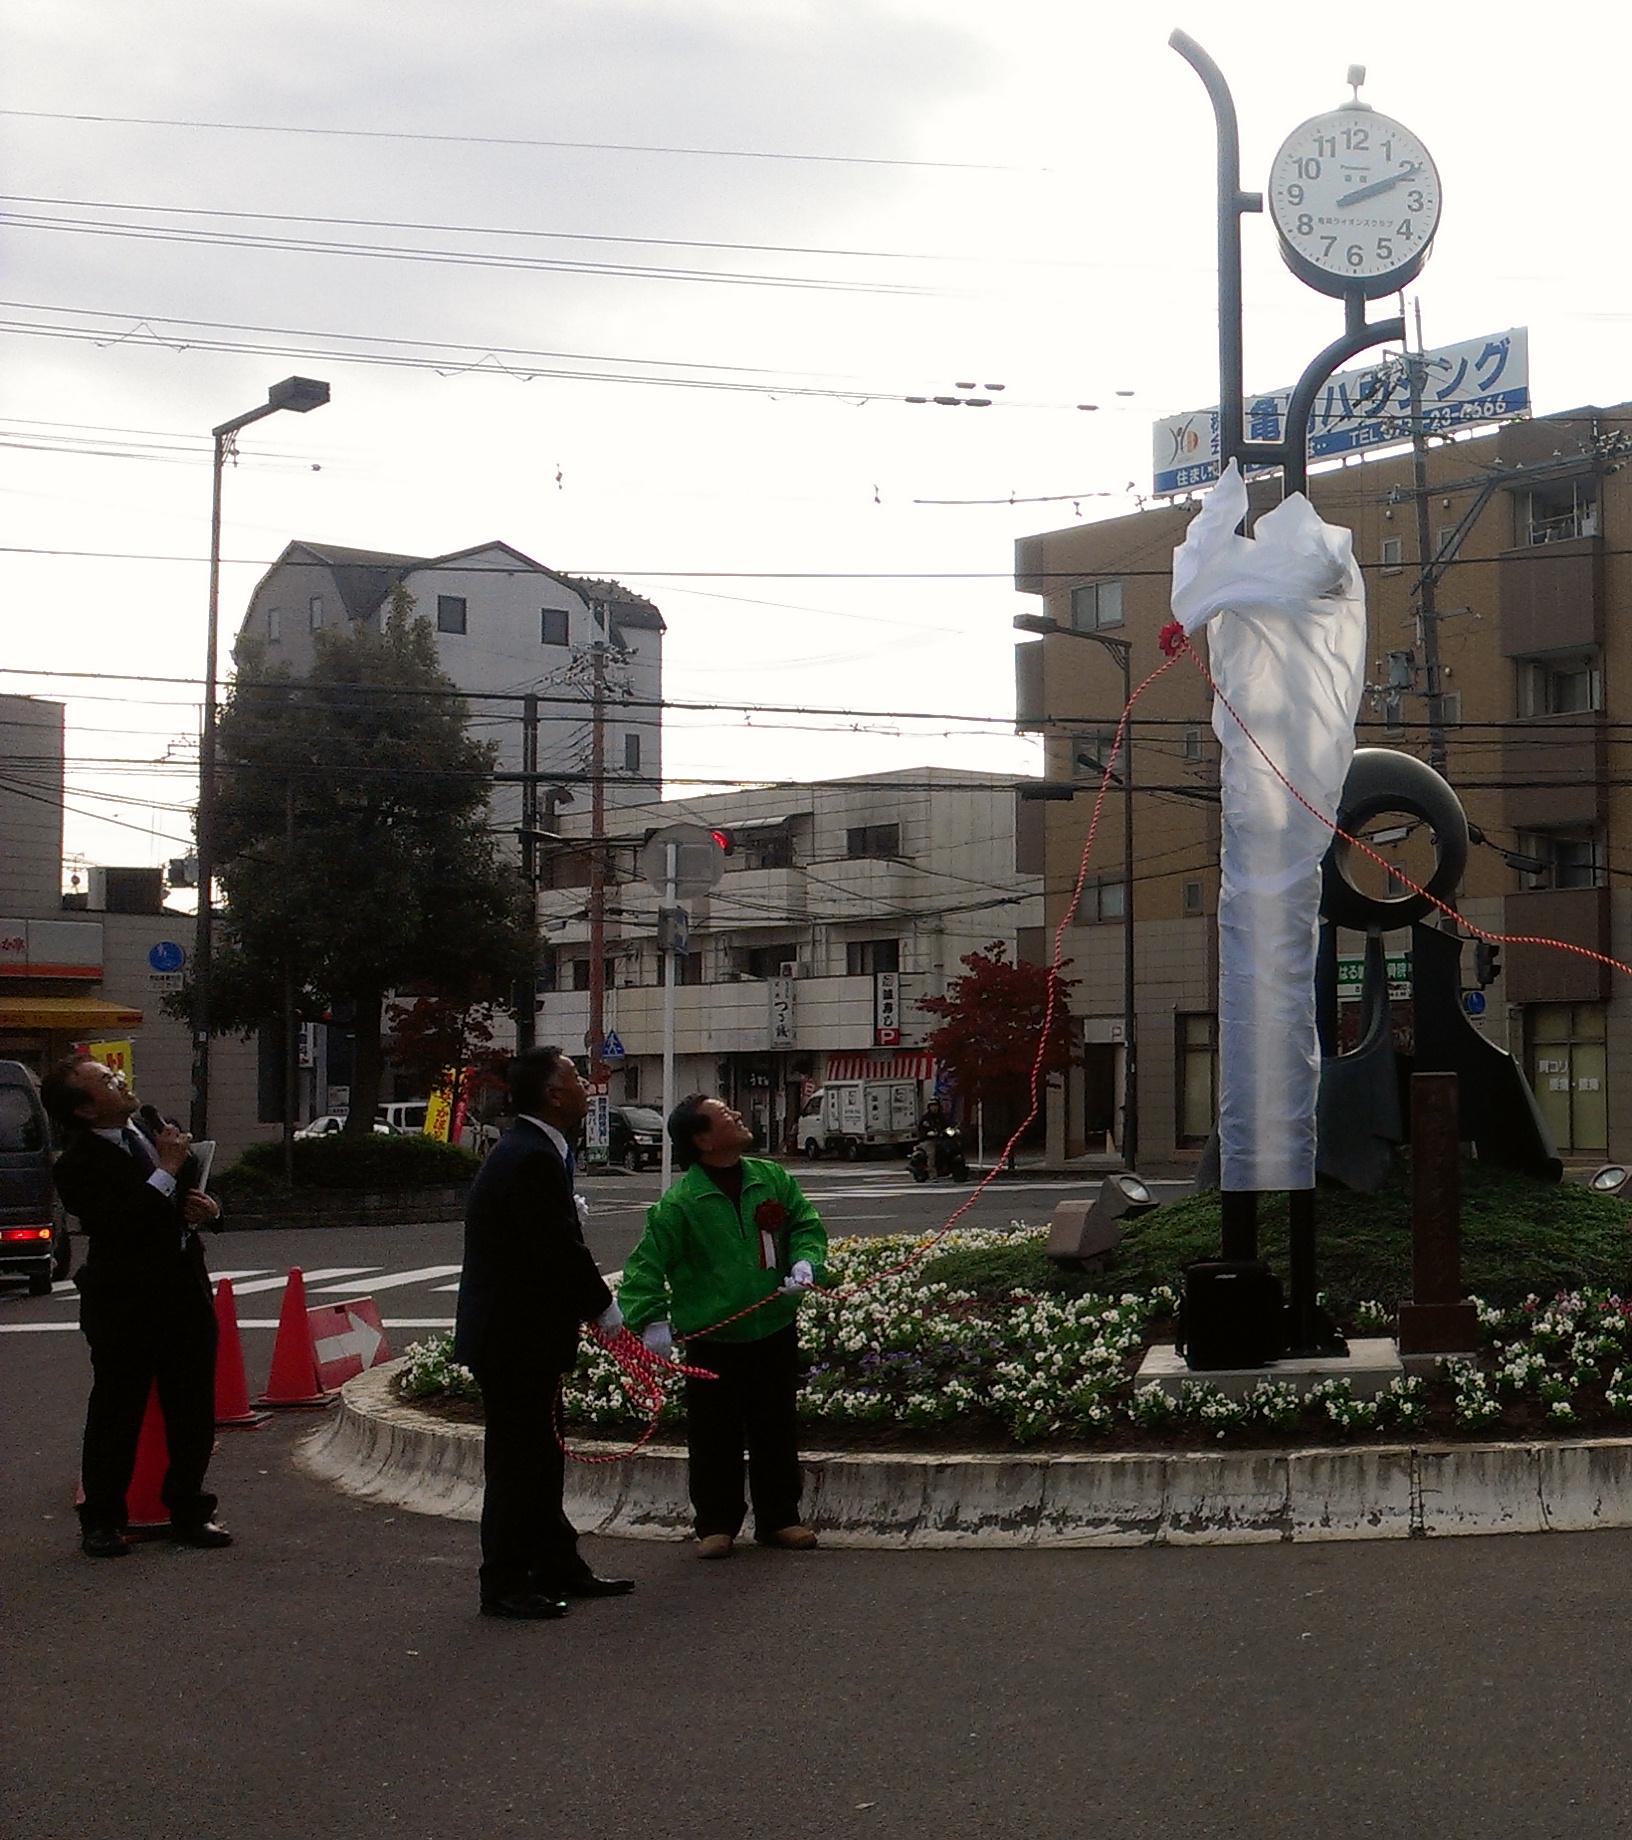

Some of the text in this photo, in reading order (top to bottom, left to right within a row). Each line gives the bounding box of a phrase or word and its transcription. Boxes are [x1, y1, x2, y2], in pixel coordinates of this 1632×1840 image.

[1313, 135, 1336, 158] 11
[1341, 128, 1369, 151] 12
[1381, 140, 1392, 162] 1
[1292, 158, 1321, 180] 10
[1399, 160, 1415, 182] 2
[1287, 184, 1304, 206] 9
[1407, 190, 1424, 212] 3
[1297, 213, 1314, 236] 8
[1396, 218, 1413, 240] 4
[1320, 235, 1337, 257] 7
[1346, 245, 1363, 267] 6
[1376, 237, 1393, 260] 5
[1350, 428, 1379, 446] TEL
[881, 1030, 896, 1045] P
